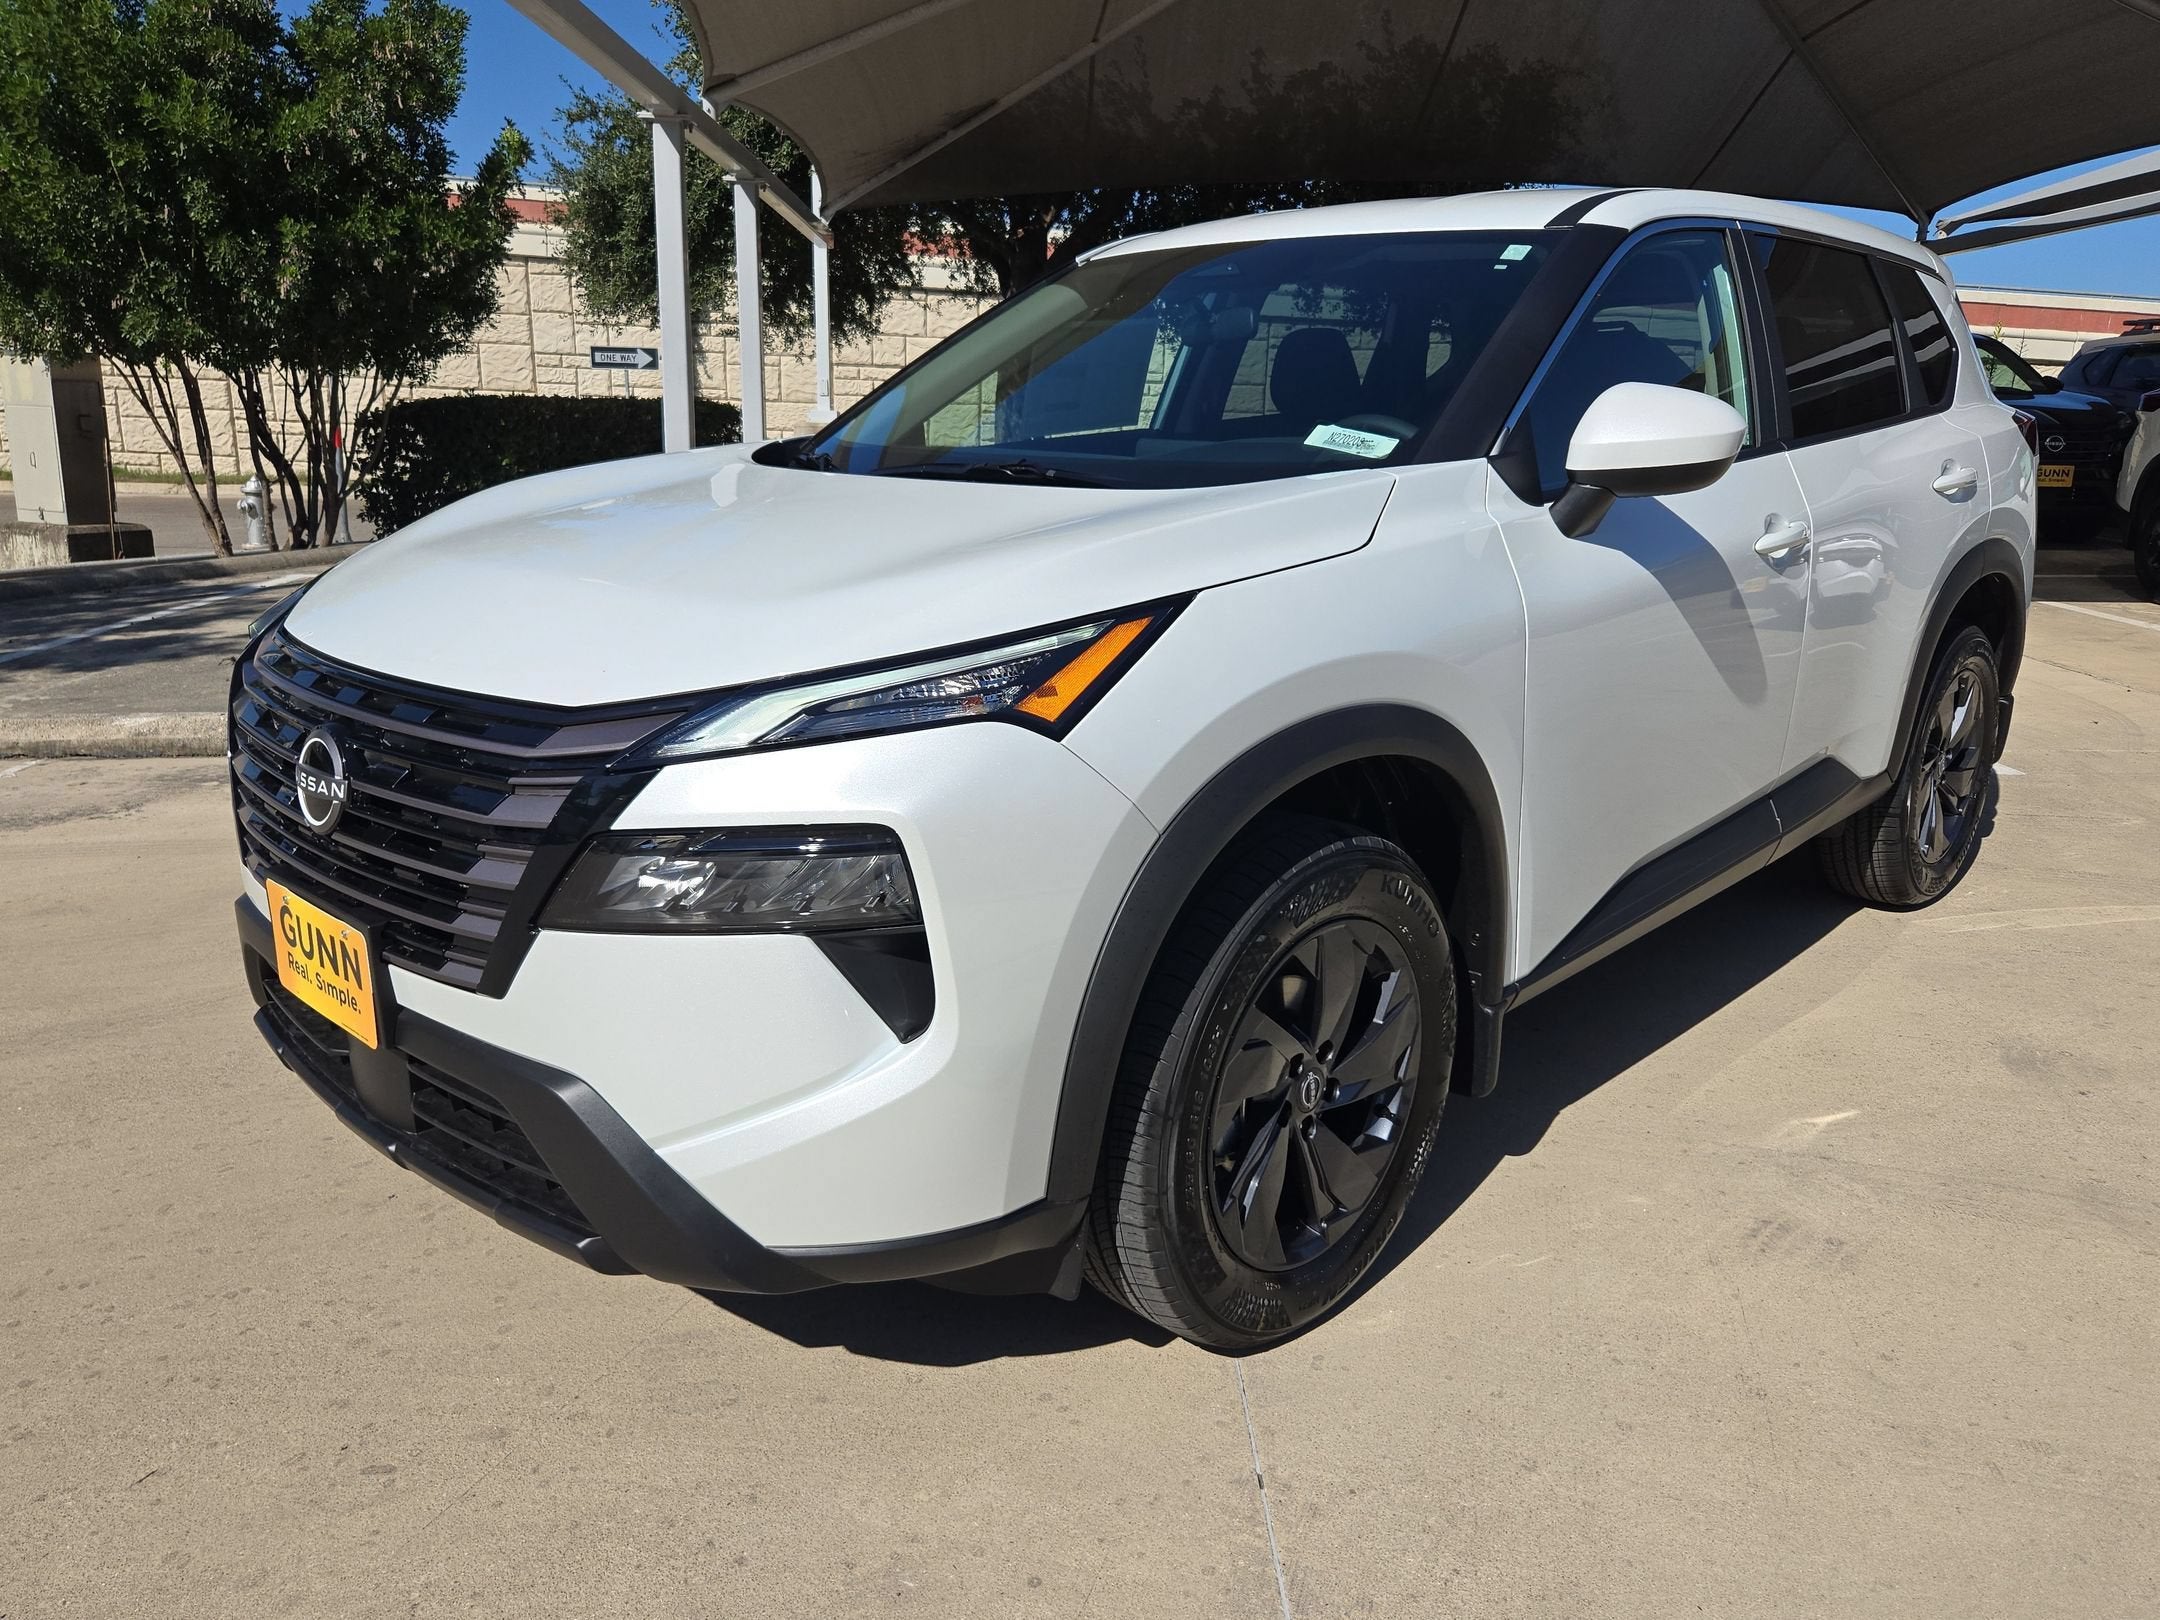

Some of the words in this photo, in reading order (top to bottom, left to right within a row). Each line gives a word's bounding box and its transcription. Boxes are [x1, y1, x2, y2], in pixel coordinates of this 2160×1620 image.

[600, 353, 617, 362] ONE
[620, 354, 637, 362] WAY
[279, 904, 363, 991] GUNN
[287, 951, 313, 984] Real.
[315, 972, 362, 1015] Simple.
